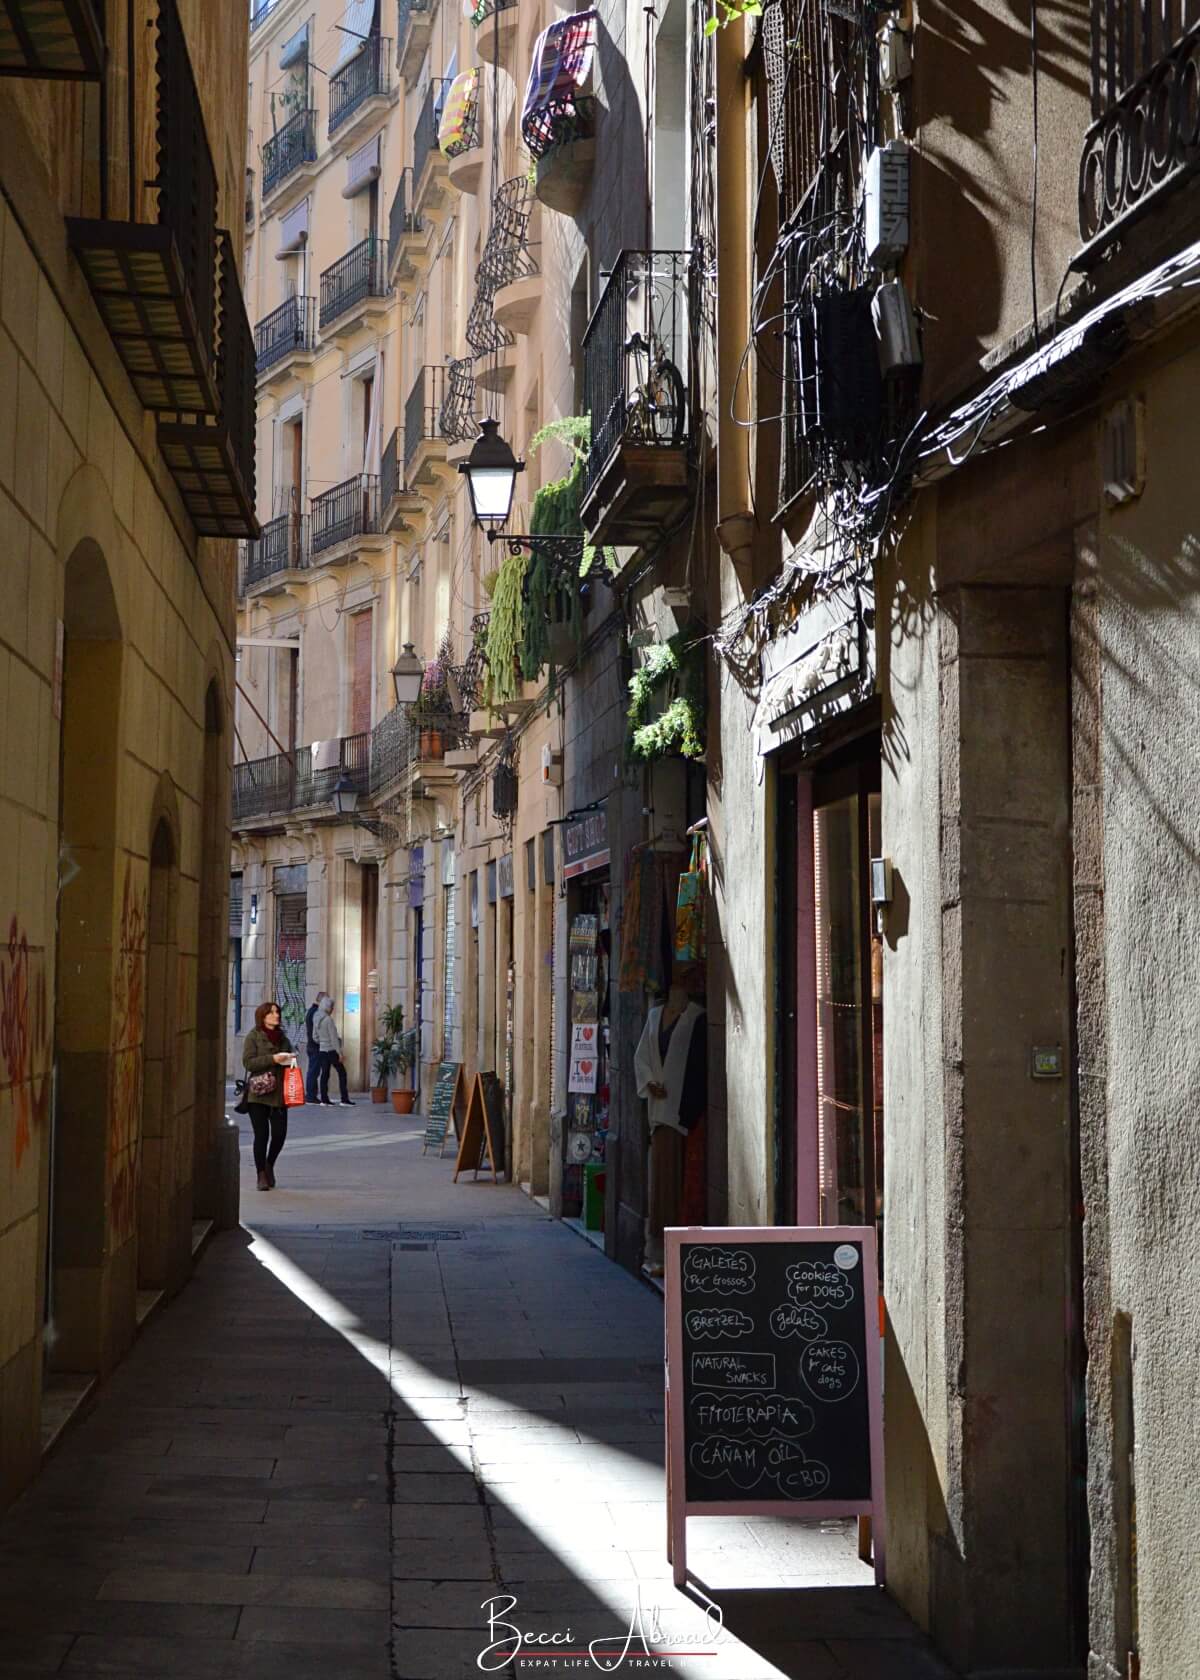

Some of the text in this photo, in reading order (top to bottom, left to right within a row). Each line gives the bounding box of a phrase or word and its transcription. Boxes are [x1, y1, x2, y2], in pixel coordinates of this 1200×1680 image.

[691, 1253, 748, 1272] GALETES
[689, 1273, 710, 1286] Per
[795, 1282, 845, 1299] for DOGS
[690, 1314, 745, 1333] BRETZEL
[776, 1309, 820, 1331] gelats
[808, 1346, 847, 1360] CAKES
[694, 1356, 747, 1372] NATURAL
[821, 1360, 846, 1376] cats
[725, 1373, 768, 1385] SNACKS
[817, 1374, 842, 1389] dogs
[786, 1470, 826, 1487] CBD
